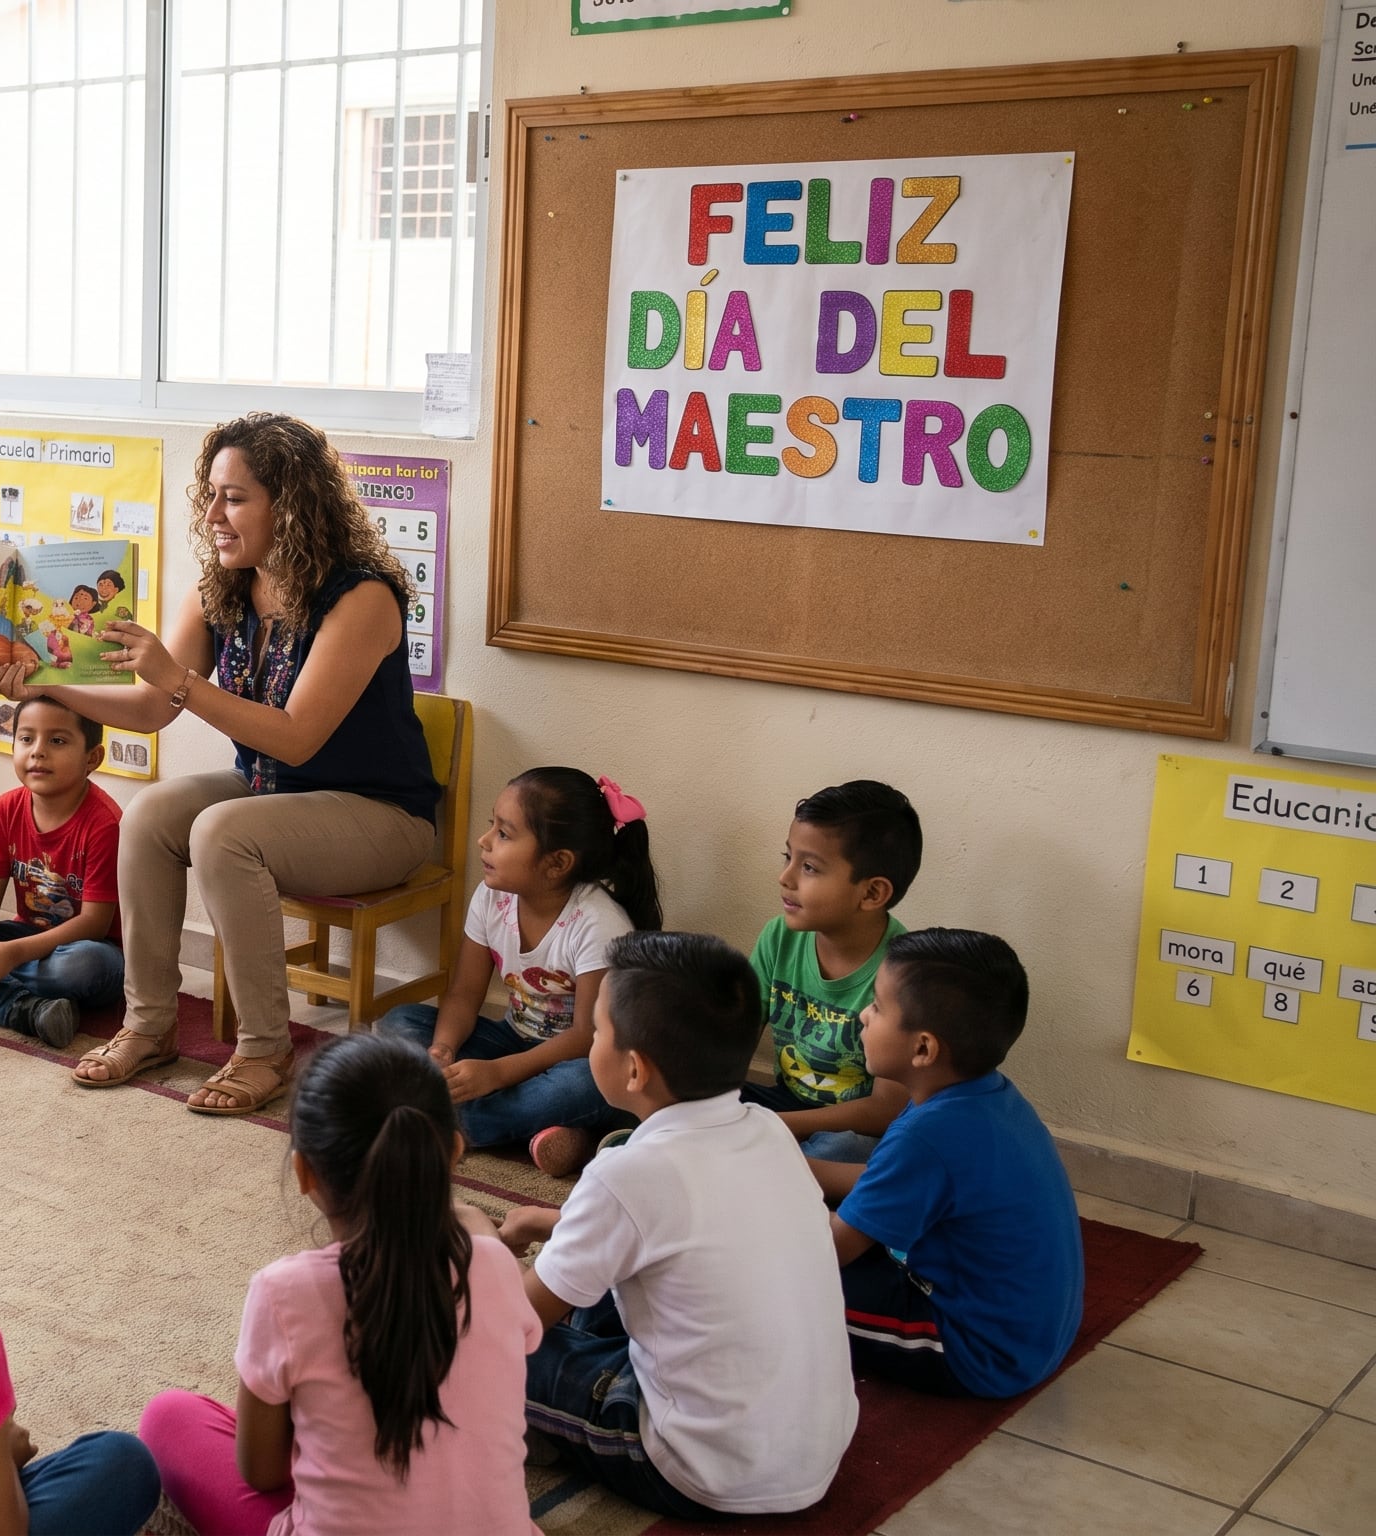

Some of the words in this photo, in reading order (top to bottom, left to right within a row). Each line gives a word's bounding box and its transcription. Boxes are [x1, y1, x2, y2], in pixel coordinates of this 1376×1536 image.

[687, 176, 961, 266] FELIZ
[627, 269, 762, 371] DÍA
[815, 289, 1007, 379] DEL
[614, 388, 1032, 493] MAESTRO
[417, 521, 428, 541] 5
[416, 562, 426, 582] 6
[414, 604, 426, 623] 9
[1198, 865, 1208, 885] 1
[1280, 880, 1295, 900] 2
[1168, 942, 1223, 965] mora
[1263, 962, 1306, 981] qué
[1186, 978, 1200, 997] 6
[1274, 992, 1288, 1012] 8
